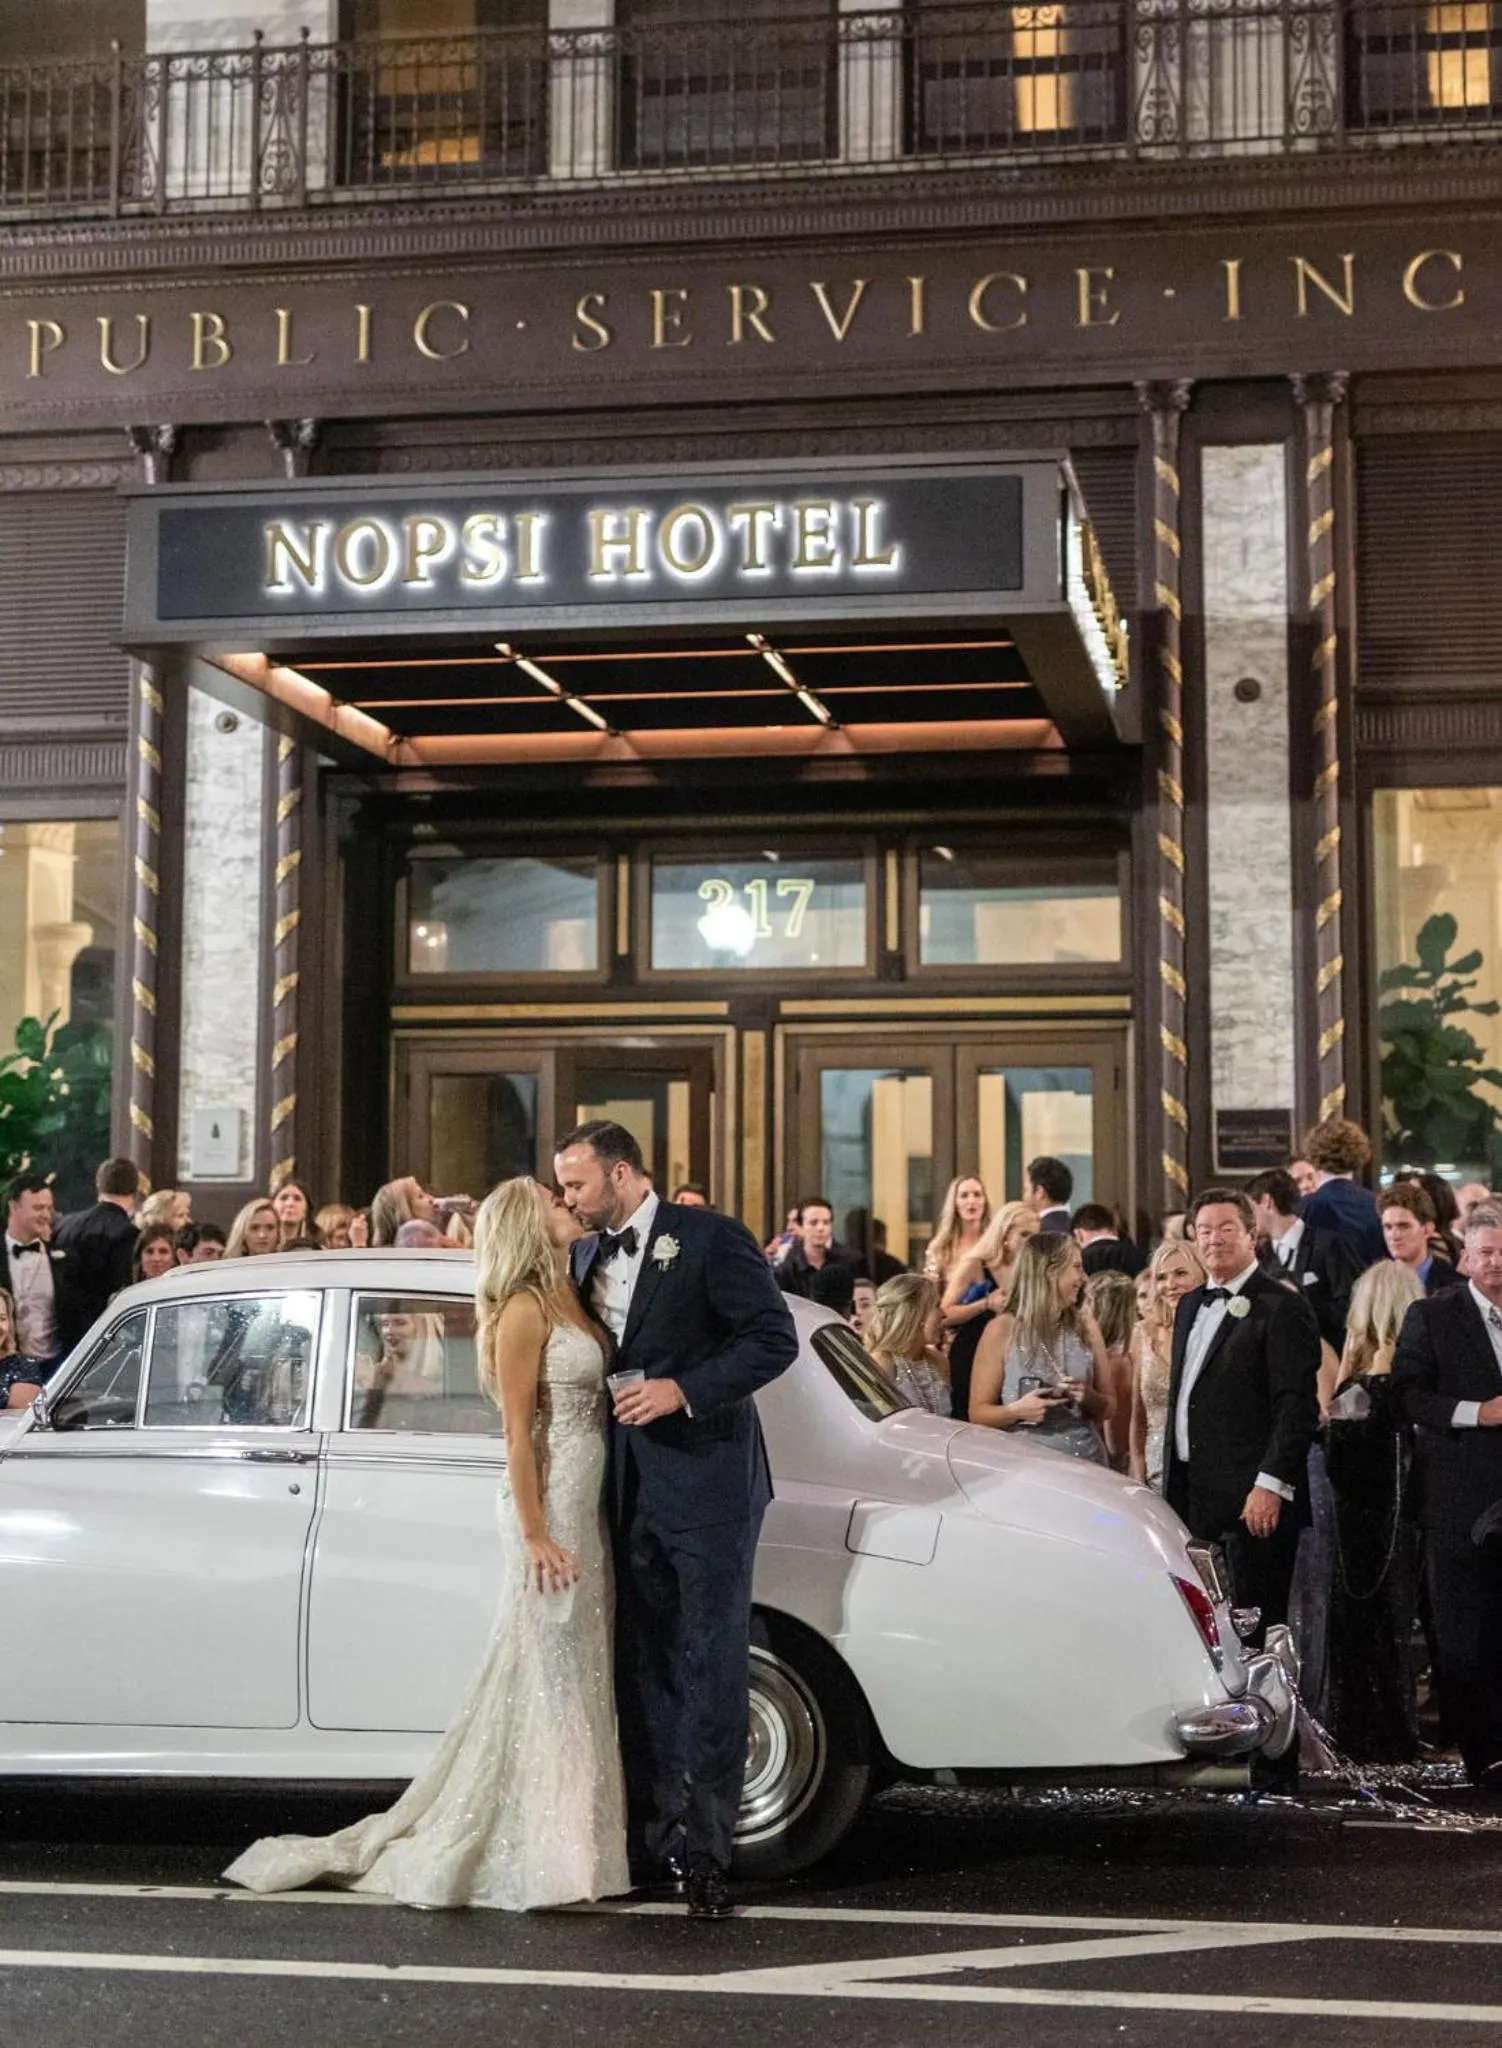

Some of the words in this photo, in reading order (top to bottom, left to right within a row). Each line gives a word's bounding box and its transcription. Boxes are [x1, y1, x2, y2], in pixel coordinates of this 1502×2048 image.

[26, 301, 470, 378] PUBLIC
[571, 267, 1120, 352] SERVICE
[1220, 249, 1465, 322] INC
[263, 511, 546, 594] NOPSI
[588, 498, 901, 583] HOTEL
